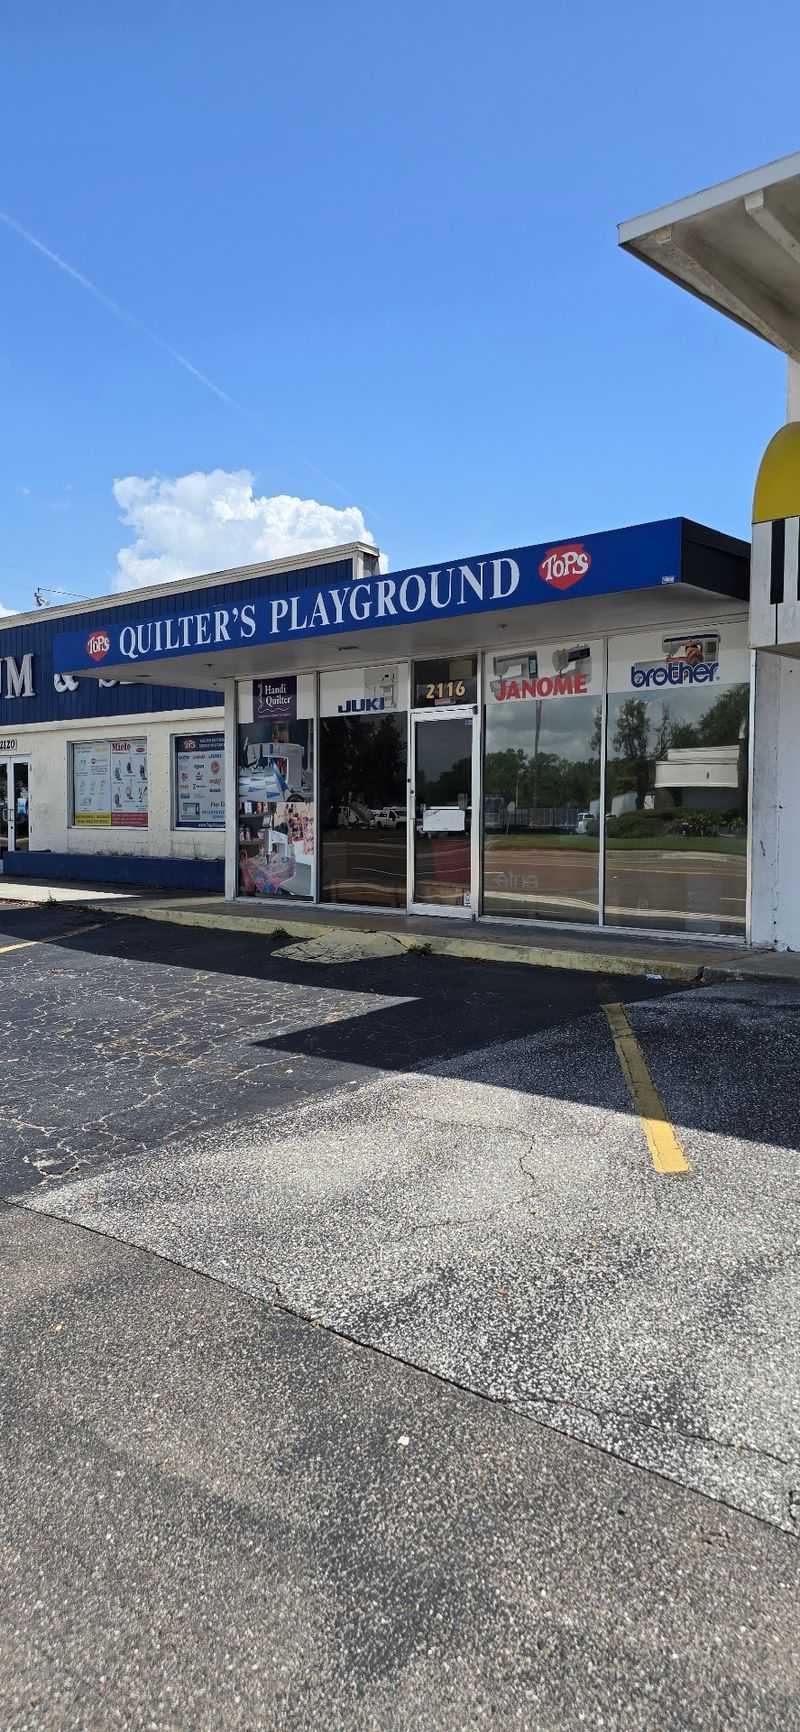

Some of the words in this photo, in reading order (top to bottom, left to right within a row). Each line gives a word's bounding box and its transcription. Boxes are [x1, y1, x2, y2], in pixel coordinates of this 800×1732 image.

[119, 604, 256, 659] QUILTER'S
[269, 557, 520, 634] PLAYGROUND
[630, 661, 718, 688] brother
[264, 683, 287, 695] Handi
[426, 681, 466, 699] 2116
[495, 672, 588, 701] JANOME
[265, 694, 292, 707] Quilter
[337, 696, 385, 713] JUKI
